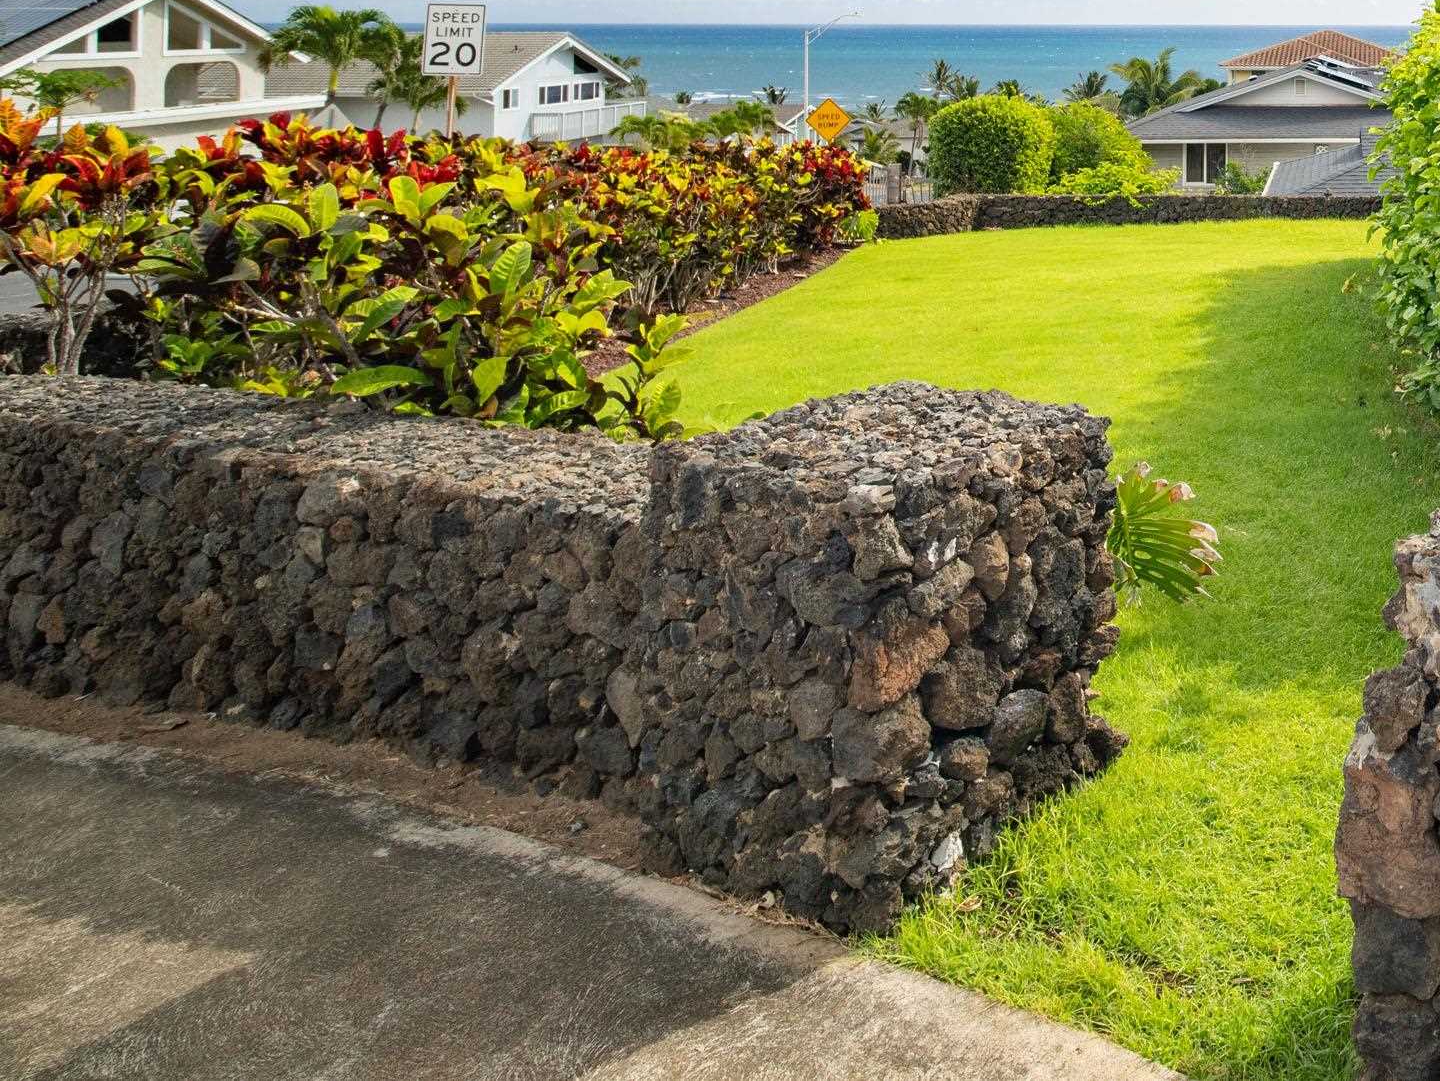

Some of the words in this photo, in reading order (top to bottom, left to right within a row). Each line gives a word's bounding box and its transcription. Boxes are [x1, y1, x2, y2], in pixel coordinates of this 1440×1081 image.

[432, 12, 480, 23] SPEED
[436, 27, 474, 38] LIMIT
[429, 42, 476, 67] 20
